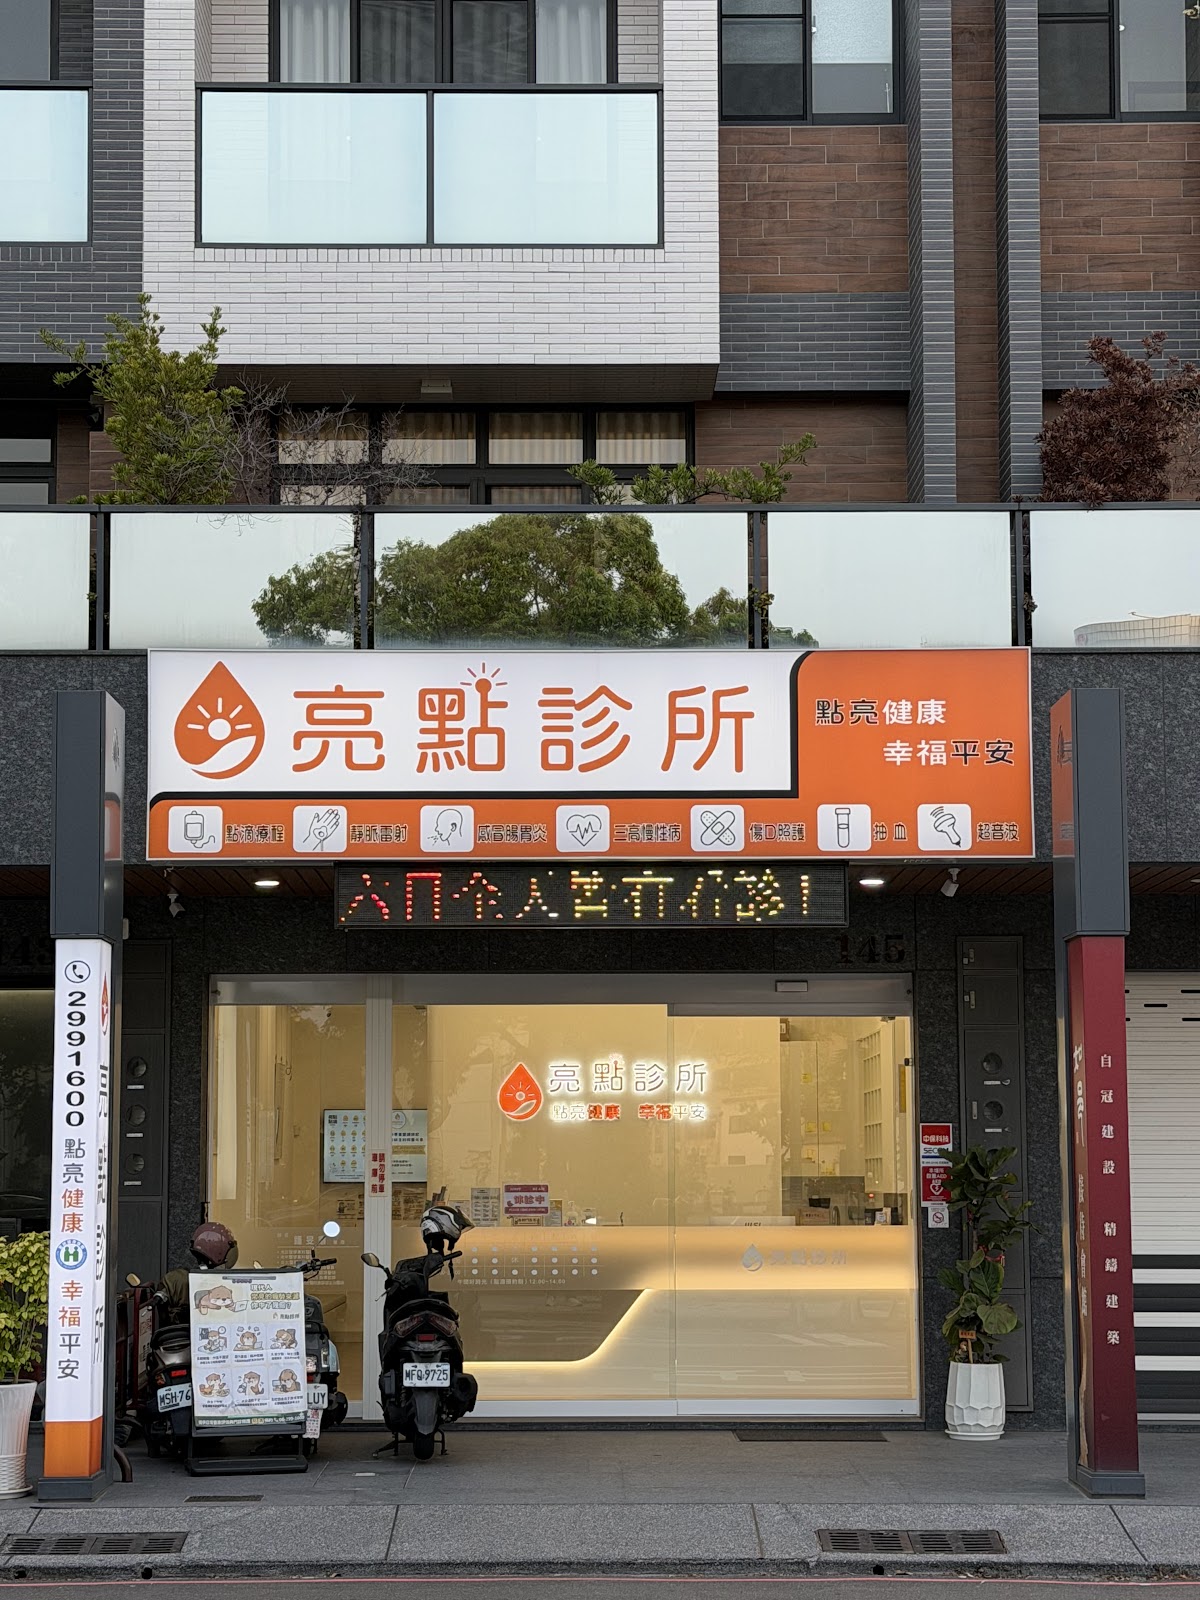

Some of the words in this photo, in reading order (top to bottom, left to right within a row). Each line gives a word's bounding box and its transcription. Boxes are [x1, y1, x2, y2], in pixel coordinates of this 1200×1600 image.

[815, 699, 947, 726] 點亮健康
[291, 677, 755, 774] 亮點診所
[882, 739, 1015, 767] 幸福平安
[225, 823, 285, 844] 點滴療程
[349, 823, 408, 844] 靜脈雷射
[477, 823, 547, 844] 感冒腸胃炎
[613, 822, 681, 843] 三高慢性病
[749, 822, 806, 842] 傷口照護
[873, 822, 908, 842] 抽血
[977, 822, 1020, 842] 超音波
[835, 933, 906, 964] 145
[65, 990, 87, 1127] 2991600
[550, 1060, 707, 1092] 亮點診所
[553, 1103, 621, 1120] 點亮健康
[638, 1103, 705, 1120] 幸福平安
[1100, 1053, 1116, 1175] 自冠建設
[923, 1134, 949, 1142] 中保科技
[378, 1152, 386, 1193] 請勿停車
[60, 1137, 86, 1234] 點亮健康
[1104, 1221, 1120, 1346] 精鑄建築
[57, 1279, 84, 1380] 幸福平安
[159, 1389, 191, 1407] MSH-76
[307, 1392, 326, 1405] LUY
